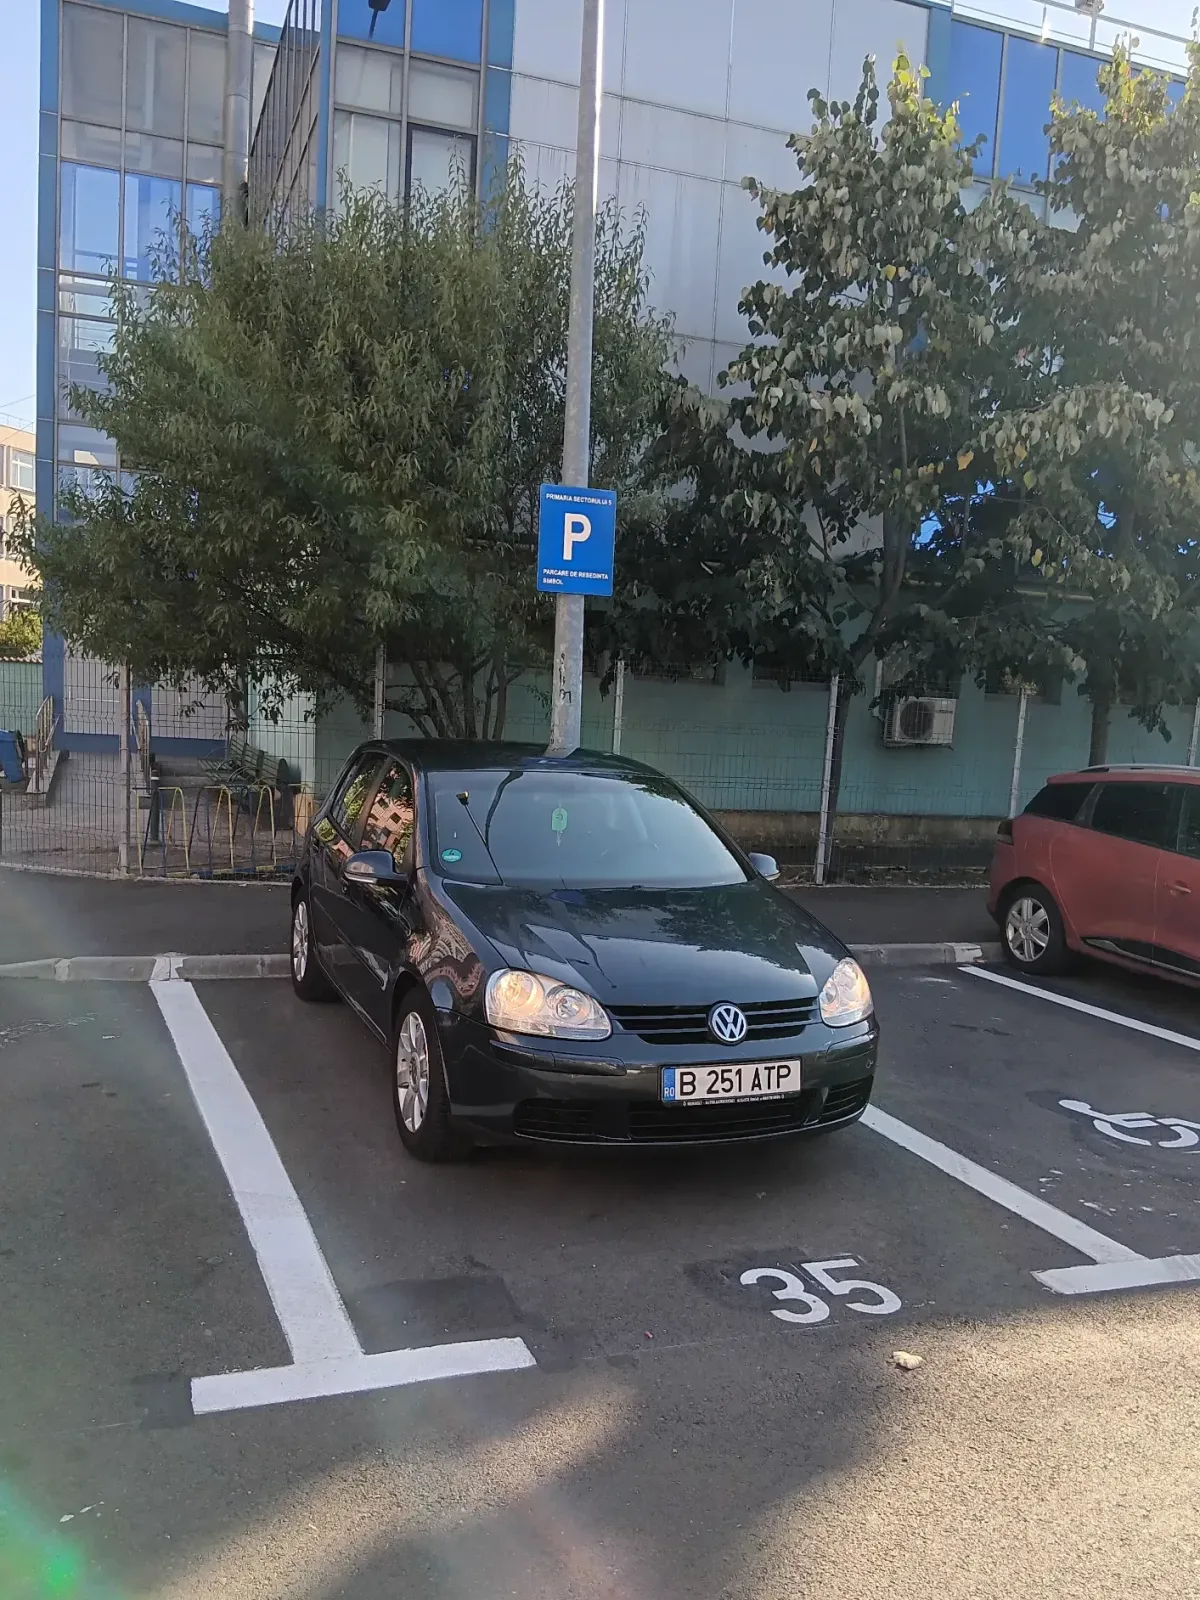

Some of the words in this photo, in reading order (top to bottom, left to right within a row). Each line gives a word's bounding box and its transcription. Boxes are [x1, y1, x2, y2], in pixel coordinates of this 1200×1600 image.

[546, 493, 572, 502] PRIMARIA
[563, 512, 592, 560] P
[543, 568, 569, 577] PARCARE
[570, 570, 578, 578] DE
[679, 1071, 696, 1097] B
[706, 1067, 742, 1095] 251
[751, 1064, 792, 1092] ATP
[664, 1086, 675, 1098] RO
[739, 1258, 903, 1324] 35
